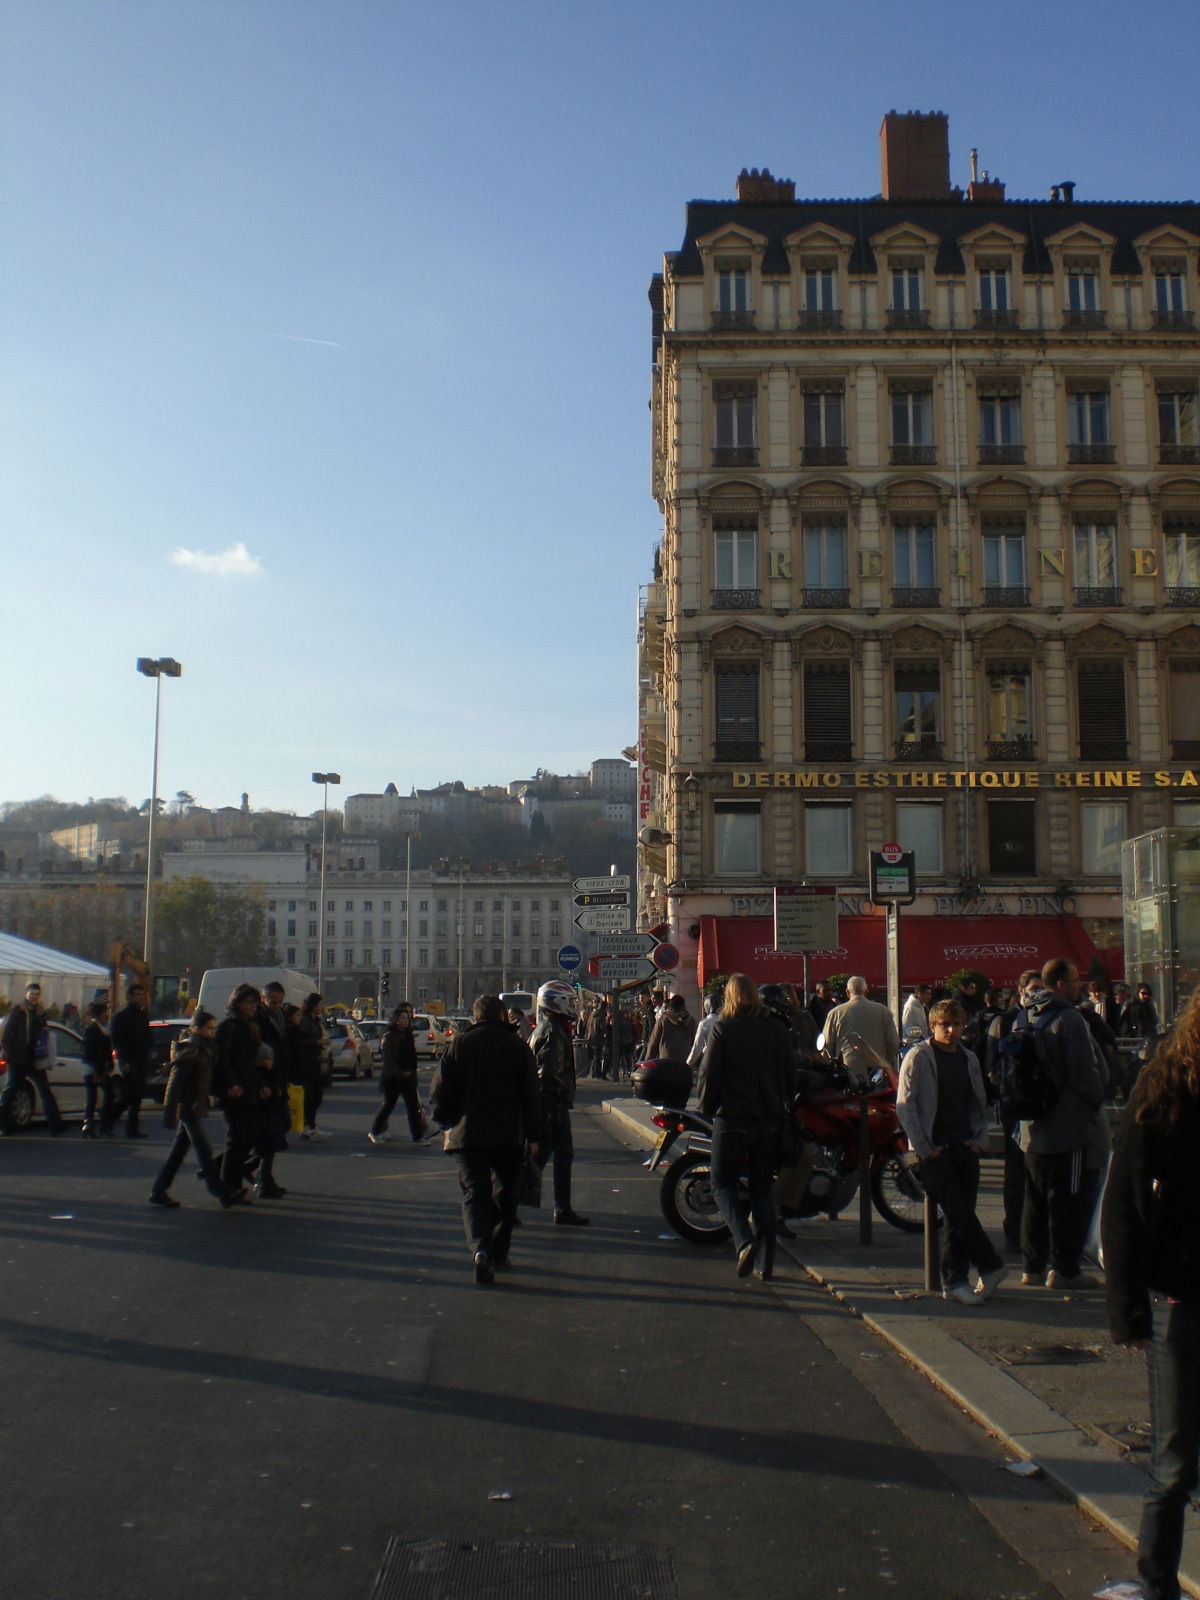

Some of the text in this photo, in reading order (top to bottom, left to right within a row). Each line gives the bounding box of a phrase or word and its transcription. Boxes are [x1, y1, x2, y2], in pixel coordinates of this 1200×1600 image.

[768, 547, 1160, 580] REINE
[732, 770, 842, 788] DERMO
[854, 770, 1040, 788] ESTHETIQUE
[1055, 770, 1142, 787] REINE
[586, 879, 625, 888] VIEUX LYON
[584, 896, 590, 905] P
[731, 897, 774, 916] PIZ
[934, 895, 1081, 916] PIZZA PINO
[595, 912, 615, 920] Office
[601, 944, 646, 952] CORDELIERS
[602, 961, 638, 969] JACOBINS
